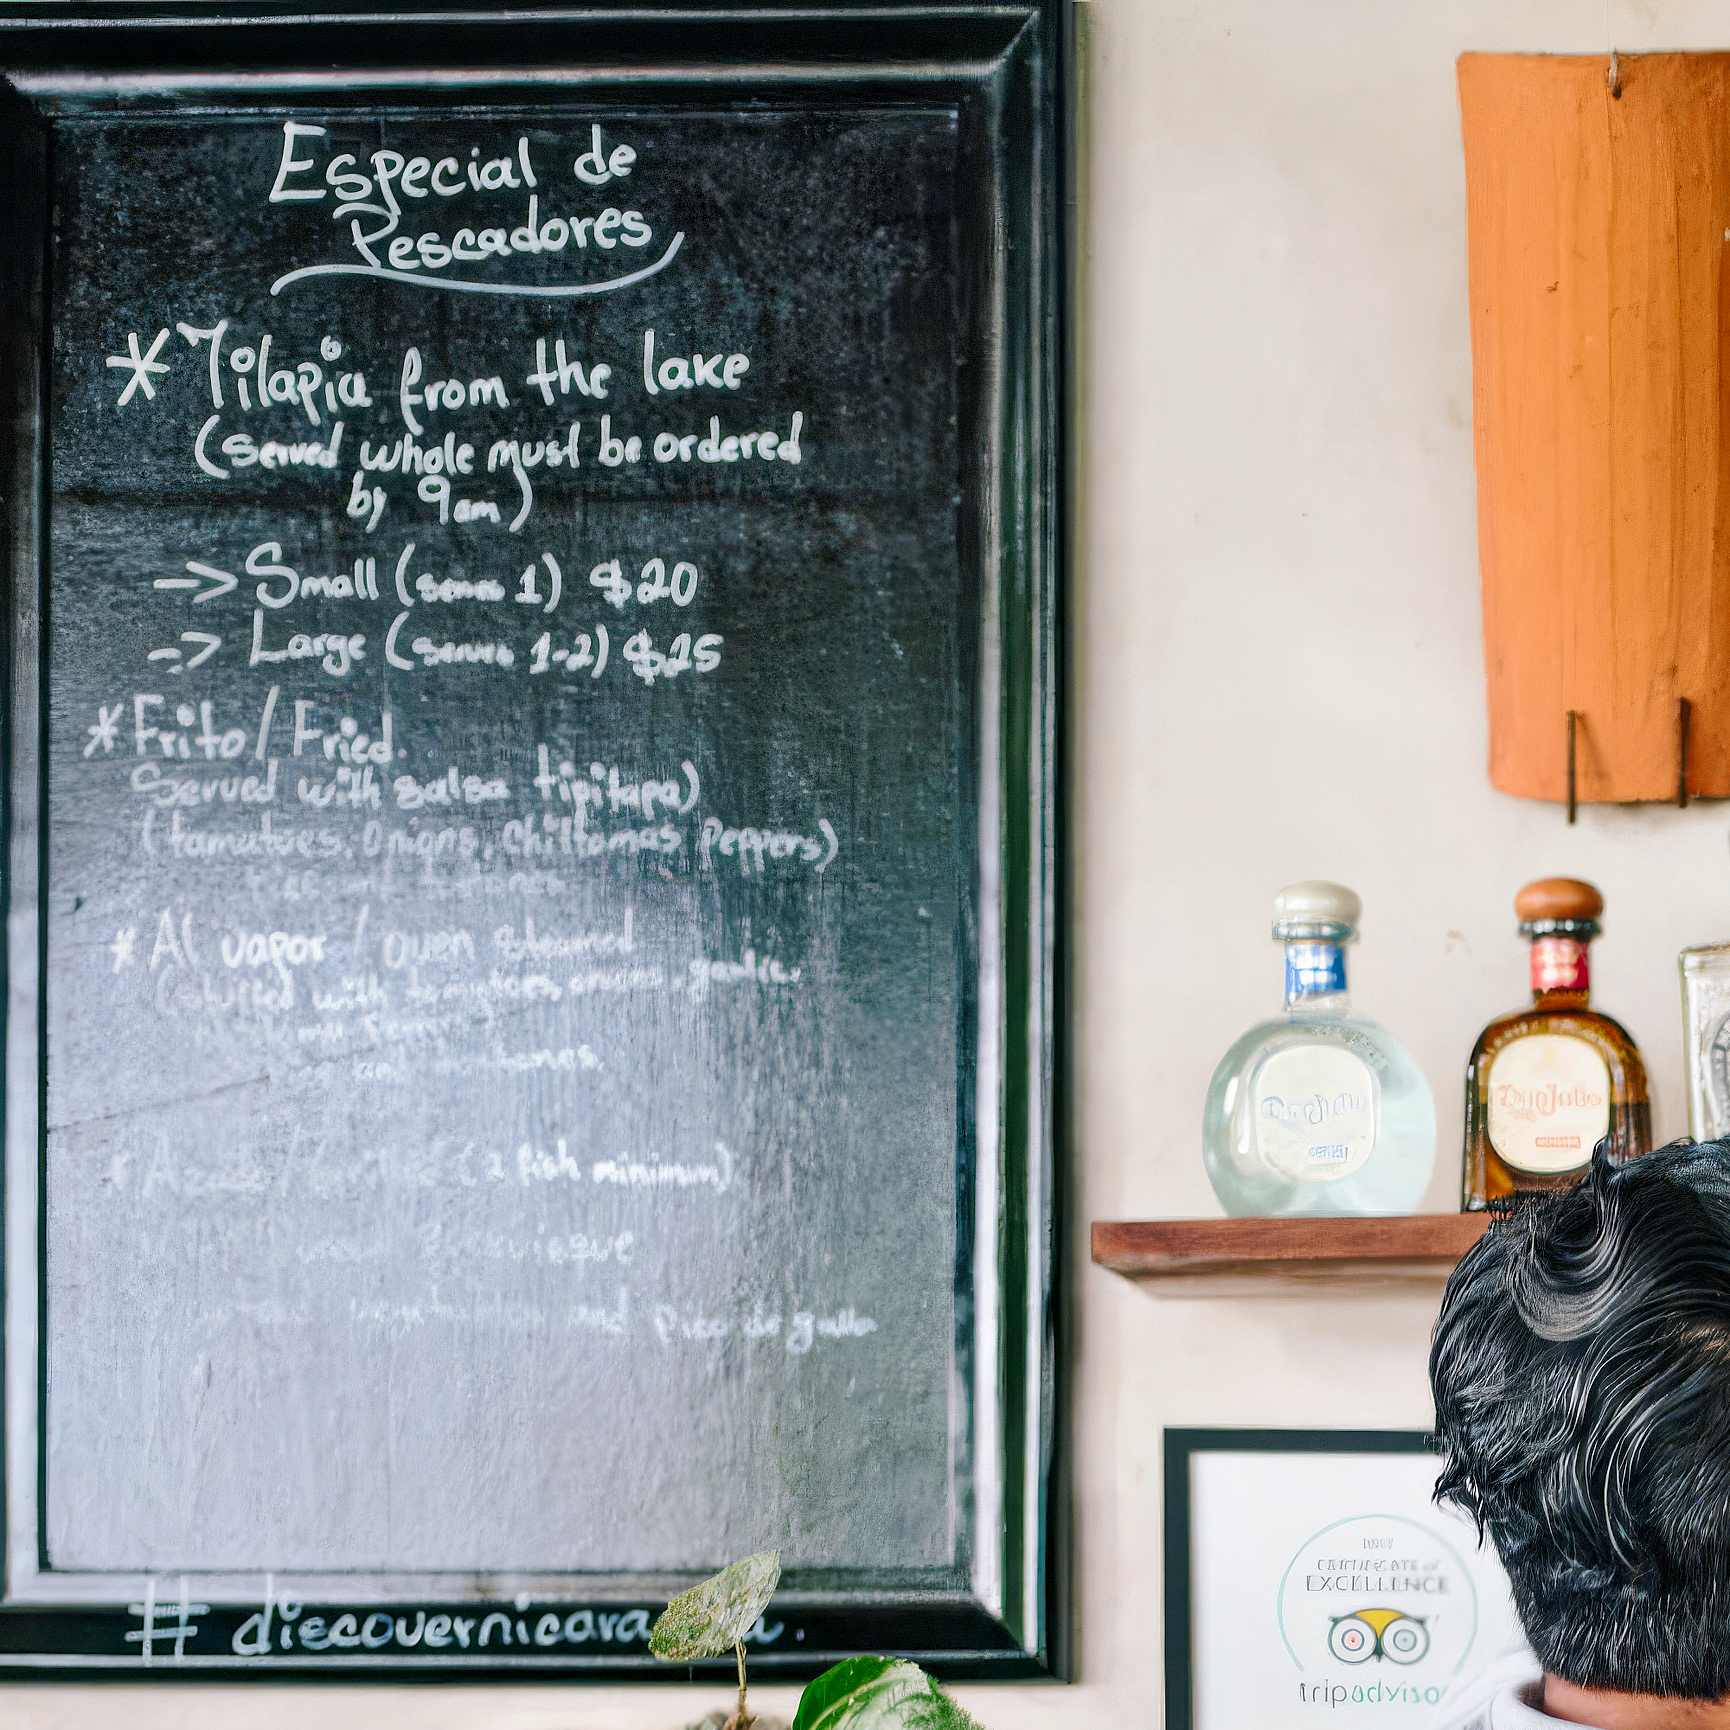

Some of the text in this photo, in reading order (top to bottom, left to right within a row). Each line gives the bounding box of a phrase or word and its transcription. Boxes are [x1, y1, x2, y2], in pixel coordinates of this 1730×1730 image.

[269, 121, 637, 215] Especial de
[333, 196, 653, 270] Pescadores
[177, 319, 750, 434] Tilapia from the lake
[359, 431, 475, 475] whole
[487, 420, 580, 472] must
[599, 414, 641, 466] be
[652, 411, 803, 466] ordered
[346, 470, 387, 532] by
[245, 542, 379, 608] Small
[590, 558, 698, 608] $20
[248, 608, 367, 677] Large
[622, 629, 724, 684] $25
[134, 694, 247, 760] Frito
[294, 700, 393, 764] Fried
[298, 766, 381, 808] with
[221, 930, 328, 974] vapor
